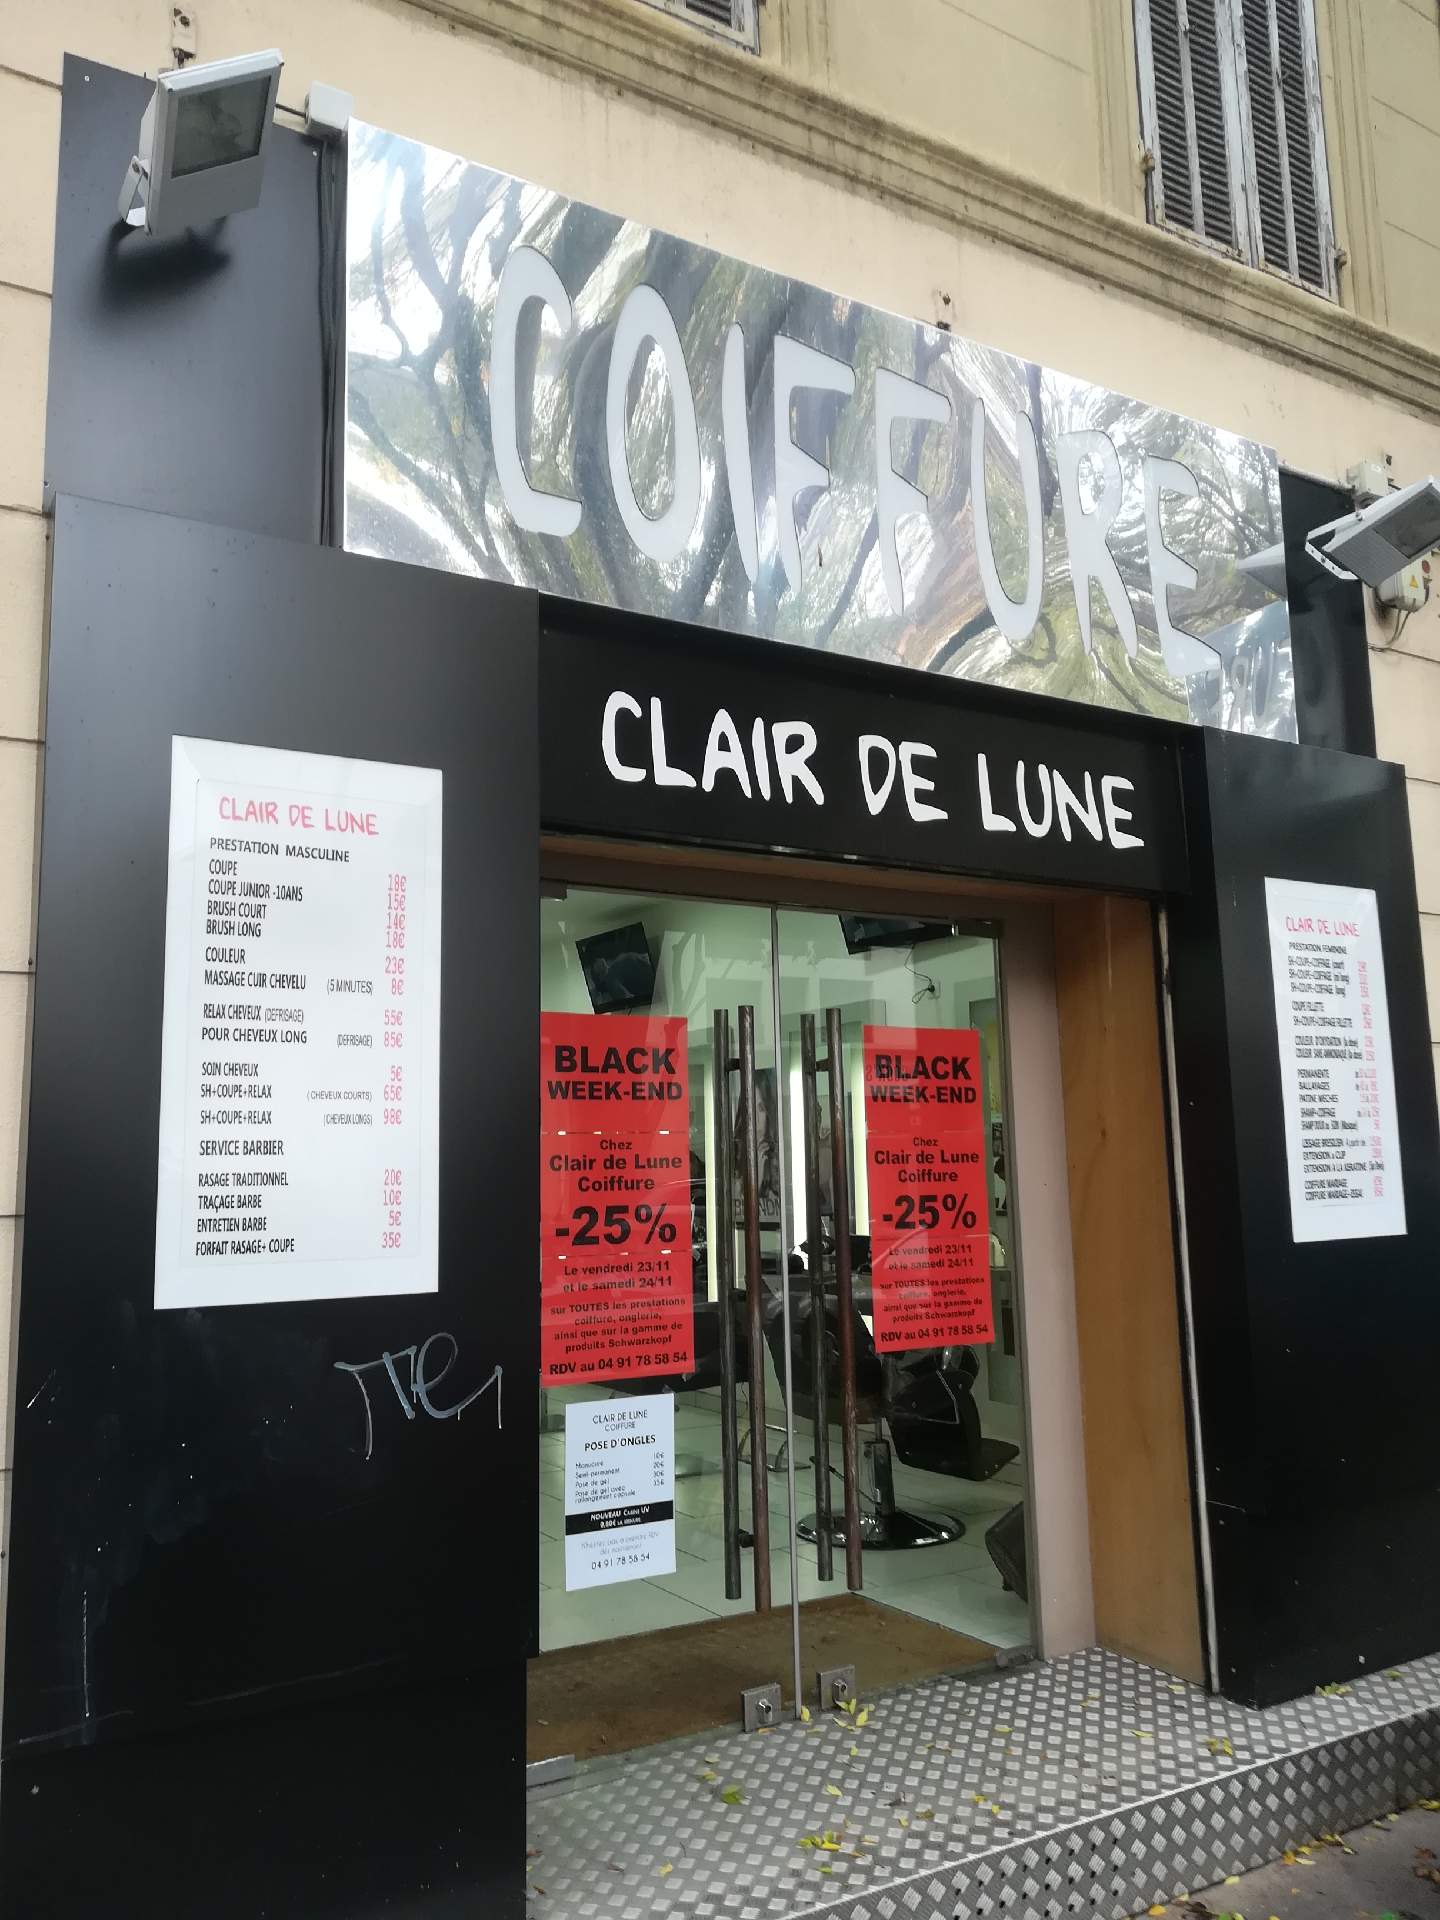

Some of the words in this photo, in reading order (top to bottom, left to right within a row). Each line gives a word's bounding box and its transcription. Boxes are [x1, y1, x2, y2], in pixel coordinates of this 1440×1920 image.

[490, 245, 1222, 677] COIFFURE
[602, 691, 824, 806] CLAIR
[859, 735, 948, 821] DE
[978, 753, 1144, 849] LUNE
[219, 796, 278, 824] CLAIR
[289, 805, 315, 828] DE
[325, 809, 379, 835] LUNE
[210, 837, 278, 855] PRESTATION
[286, 845, 349, 862] MASCULINE
[209, 859, 237, 875] COUPE
[208, 879, 236, 896] COUPE
[239, 882, 270, 898] JUNIOR
[273, 885, 302, 901] -10ANS
[388, 875, 406, 892] 18€
[208, 900, 236, 917] BRUSH
[238, 902, 266, 918] COURT
[387, 895, 405, 911] 15€
[206, 919, 235, 936] BRUSH
[238, 921, 261, 938] LONG
[386, 912, 405, 930] 14€
[1286, 917, 1313, 932] CLAIR
[1318, 920, 1331, 934] DE
[1334, 921, 1360, 937] LUNE
[386, 932, 405, 948] 18€
[206, 947, 245, 964] COULEUR
[385, 956, 405, 974] 23€
[205, 970, 245, 987] MASSAGE
[247, 972, 266, 988] CUIR
[270, 973, 306, 989] CHEVELU
[336, 979, 372, 994] MINUTES)
[391, 978, 404, 995] 8€
[203, 1004, 226, 1019] RELAX
[228, 1005, 261, 1020] CHEVEUX
[384, 1009, 403, 1025] 55€
[202, 1027, 229, 1042] POUR
[233, 1029, 277, 1043] CHEVEUX
[281, 1030, 307, 1044] LONG
[384, 1032, 402, 1047] 85€
[555, 1045, 676, 1074] BLACK
[876, 1055, 972, 1080] BLACK
[202, 1062, 221, 1076] SOIN
[224, 1063, 258, 1077] CHEVEUX
[390, 1066, 402, 1081] 5€
[201, 1084, 272, 1099] SH+COUPE+RELAX
[384, 1085, 402, 1101] 65€
[548, 1080, 682, 1100] WEEK-END
[870, 1085, 976, 1104] WEEK-END
[201, 1110, 272, 1124] SH+COUPE+RELAX
[384, 1109, 402, 1125] 98€
[200, 1140, 239, 1155] SERVICE
[243, 1140, 284, 1155] BARBIER
[600, 1140, 632, 1150] Chez
[913, 1137, 938, 1147] Chez
[550, 1155, 595, 1171] Clair
[603, 1155, 626, 1170] de
[635, 1154, 682, 1169] Lune
[875, 1151, 911, 1165] Clair
[916, 1150, 934, 1163] de
[941, 1150, 979, 1163] Lune
[199, 1172, 229, 1186] RASAGE
[232, 1172, 288, 1186] TRADITIONNEL
[384, 1169, 402, 1186] 20€
[578, 1176, 655, 1192] Coiffure
[898, 1169, 958, 1183] Coiffure
[199, 1195, 235, 1213] TRAÇAGE
[237, 1195, 262, 1208] BARBE
[383, 1190, 401, 1206] 10€
[389, 1211, 401, 1226] 5€
[883, 1194, 976, 1229] -25%
[197, 1218, 240, 1233] ENTRETIEN
[242, 1217, 266, 1232] BARBE
[556, 1203, 676, 1246] -25%
[196, 1241, 228, 1256] FORFAIT
[231, 1240, 266, 1254] RASAGE+
[269, 1239, 294, 1253] COUPE
[382, 1232, 401, 1248] 35€
[901, 1246, 942, 1255] vendredi
[945, 1245, 971, 1254] 23/11
[565, 1266, 577, 1276] Le
[582, 1262, 632, 1274] vendredi
[637, 1261, 669, 1272] 23/11
[911, 1259, 944, 1270] samedi
[948, 1258, 973, 1267] 24/11
[563, 1282, 573, 1292] et
[578, 1280, 588, 1291] le
[592, 1278, 635, 1290] samedi
[639, 1276, 672, 1287] 24/11
[569, 1302, 609, 1312] TOUTES
[613, 1301, 626, 1309] les
[630, 1298, 685, 1310] prestations
[893, 1313, 922, 1323] produits
[555, 1329, 577, 1340] ainsi
[581, 1328, 597, 1339] que
[602, 1327, 616, 1335] sur
[621, 1325, 629, 1334] la
[632, 1324, 667, 1335] gamme
[671, 1322, 682, 1330] de
[881, 1332, 901, 1342] RDV
[918, 1329, 930, 1338] 04
[933, 1328, 944, 1337] 91
[948, 1327, 958, 1335] 78
[962, 1325, 973, 1334] 58
[976, 1324, 988, 1333] 54
[566, 1342, 605, 1354] produits
[608, 1335, 672, 1348] Schwarzkopf
[550, 1362, 576, 1375] RDV
[581, 1361, 594, 1372] au
[599, 1359, 612, 1370] 04
[618, 1357, 631, 1368] 91
[636, 1355, 651, 1366] 78
[655, 1353, 669, 1364] 58
[673, 1352, 687, 1362] 54
[593, 1413, 615, 1424] CLAIR
[617, 1412, 626, 1421] DE
[629, 1410, 647, 1420] LUNE
[605, 1422, 635, 1431] COIFFURE
[584, 1441, 608, 1452] POSE
[610, 1434, 655, 1448] D'ONGLES
[591, 1511, 621, 1521] NOUVEAU
[592, 1559, 601, 1569] 04
[605, 1557, 612, 1567] 91
[617, 1556, 625, 1565] 78
[629, 1554, 638, 1563] 58
[641, 1553, 650, 1561] 54
